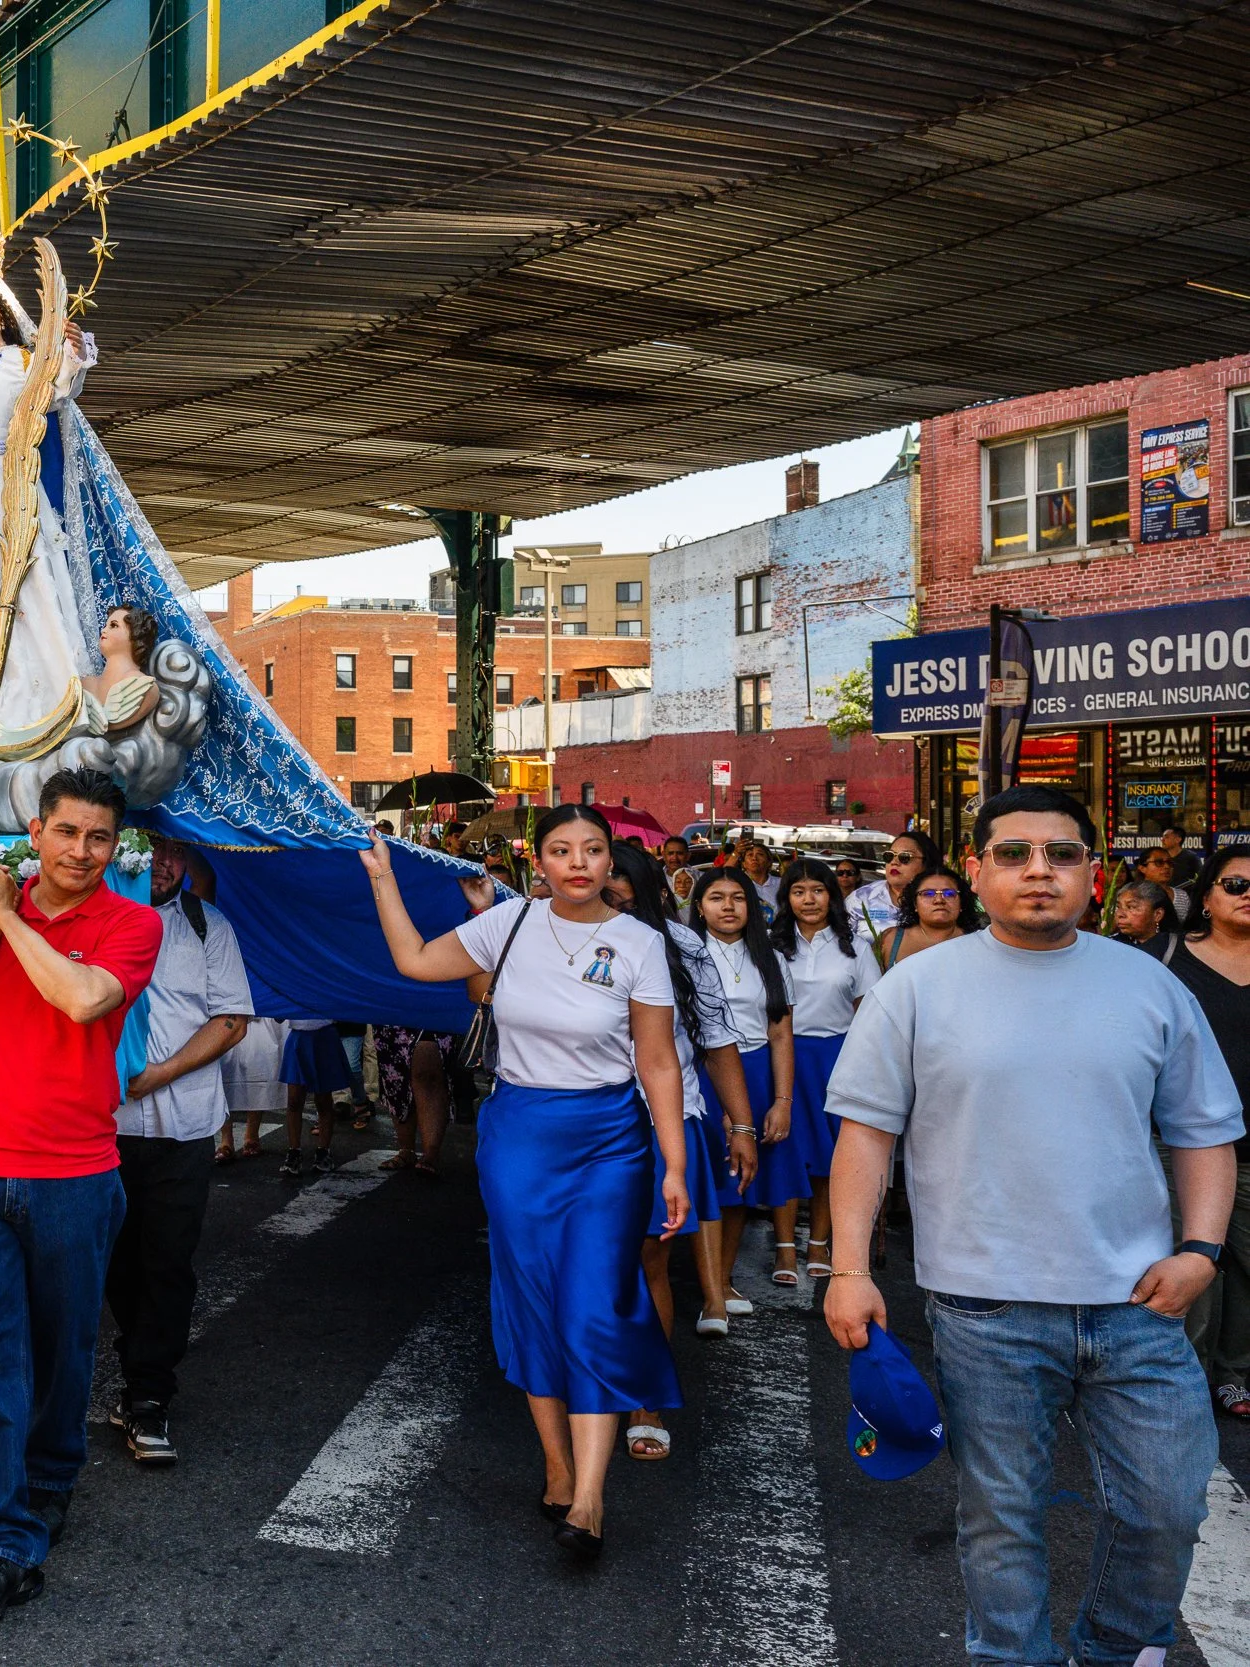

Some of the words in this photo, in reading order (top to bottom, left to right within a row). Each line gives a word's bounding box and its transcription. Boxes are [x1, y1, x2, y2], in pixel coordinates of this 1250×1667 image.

[1142, 436, 1158, 448] DMV
[1158, 431, 1184, 446] EXPRESS
[1184, 427, 1208, 441] SERVICE
[886, 657, 966, 697] JESSI
[979, 642, 1114, 689] VING
[1127, 627, 1250, 677] SCHOO
[901, 704, 959, 723] EXPRESS
[963, 703, 986, 718] DM
[1033, 697, 1066, 714] ICES
[1084, 690, 1158, 711] GENERAL
[1162, 682, 1250, 705] INSURANC
[1127, 783, 1182, 796] INSURANCE
[1128, 796, 1179, 807] AGENCY
[1112, 837, 1135, 849] JESSI
[1136, 837, 1162, 849] DRIVIN
[1182, 837, 1203, 849] HOOL
[1217, 834, 1235, 844] DMV
